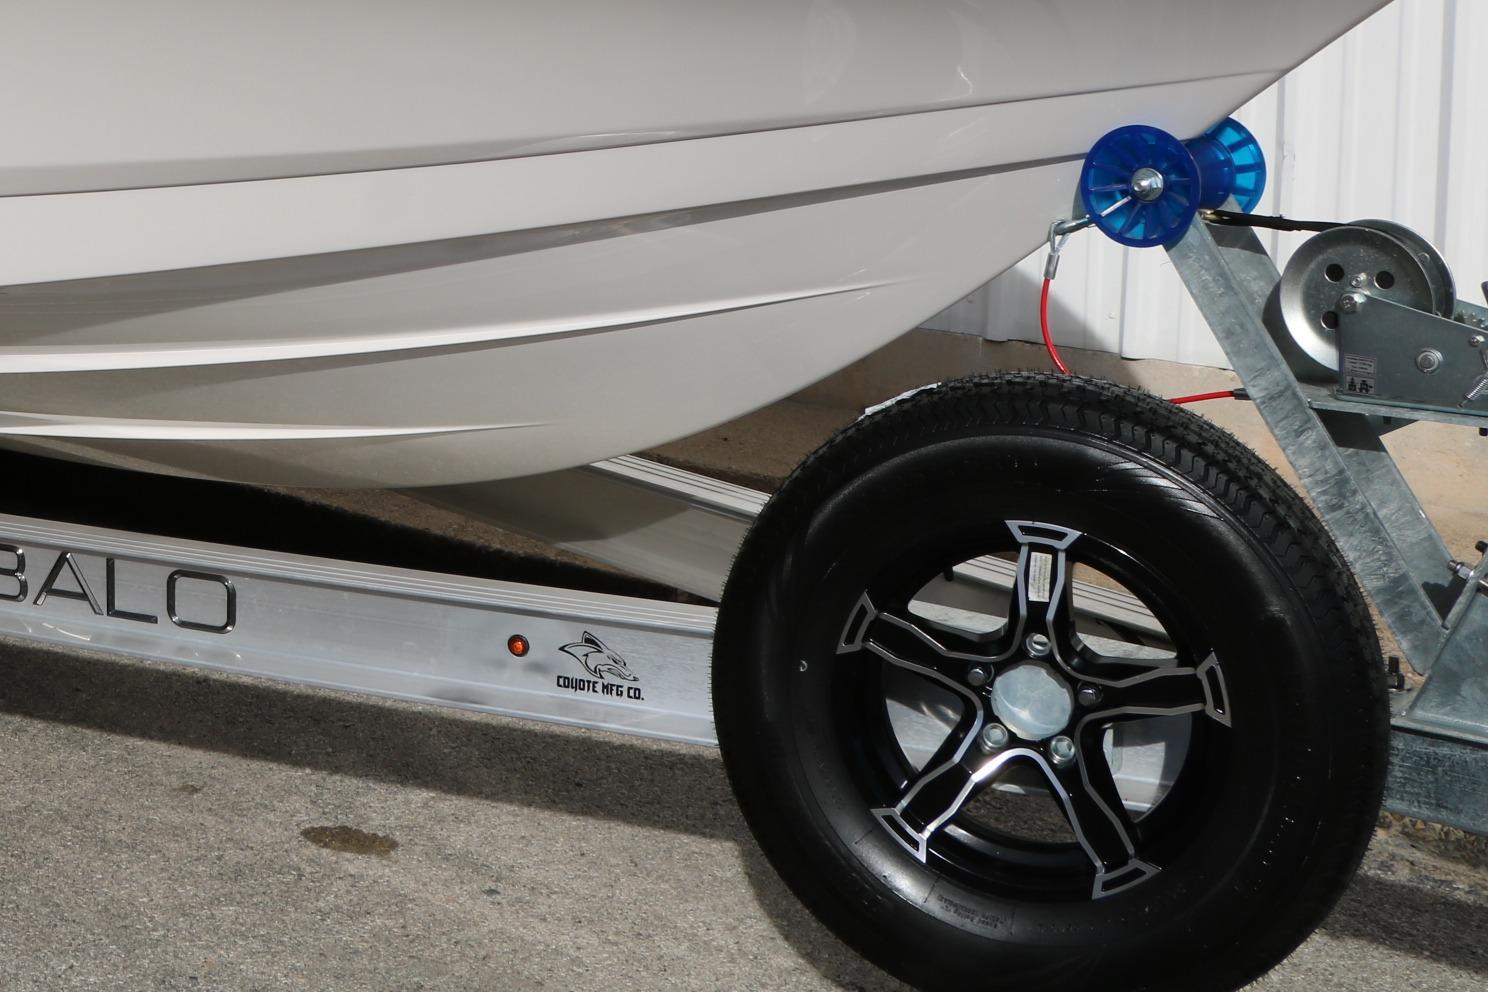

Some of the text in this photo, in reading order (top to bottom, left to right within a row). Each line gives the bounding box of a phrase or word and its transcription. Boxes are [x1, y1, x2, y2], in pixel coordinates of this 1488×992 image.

[557, 675, 645, 700] COYOTE MFG CO.
